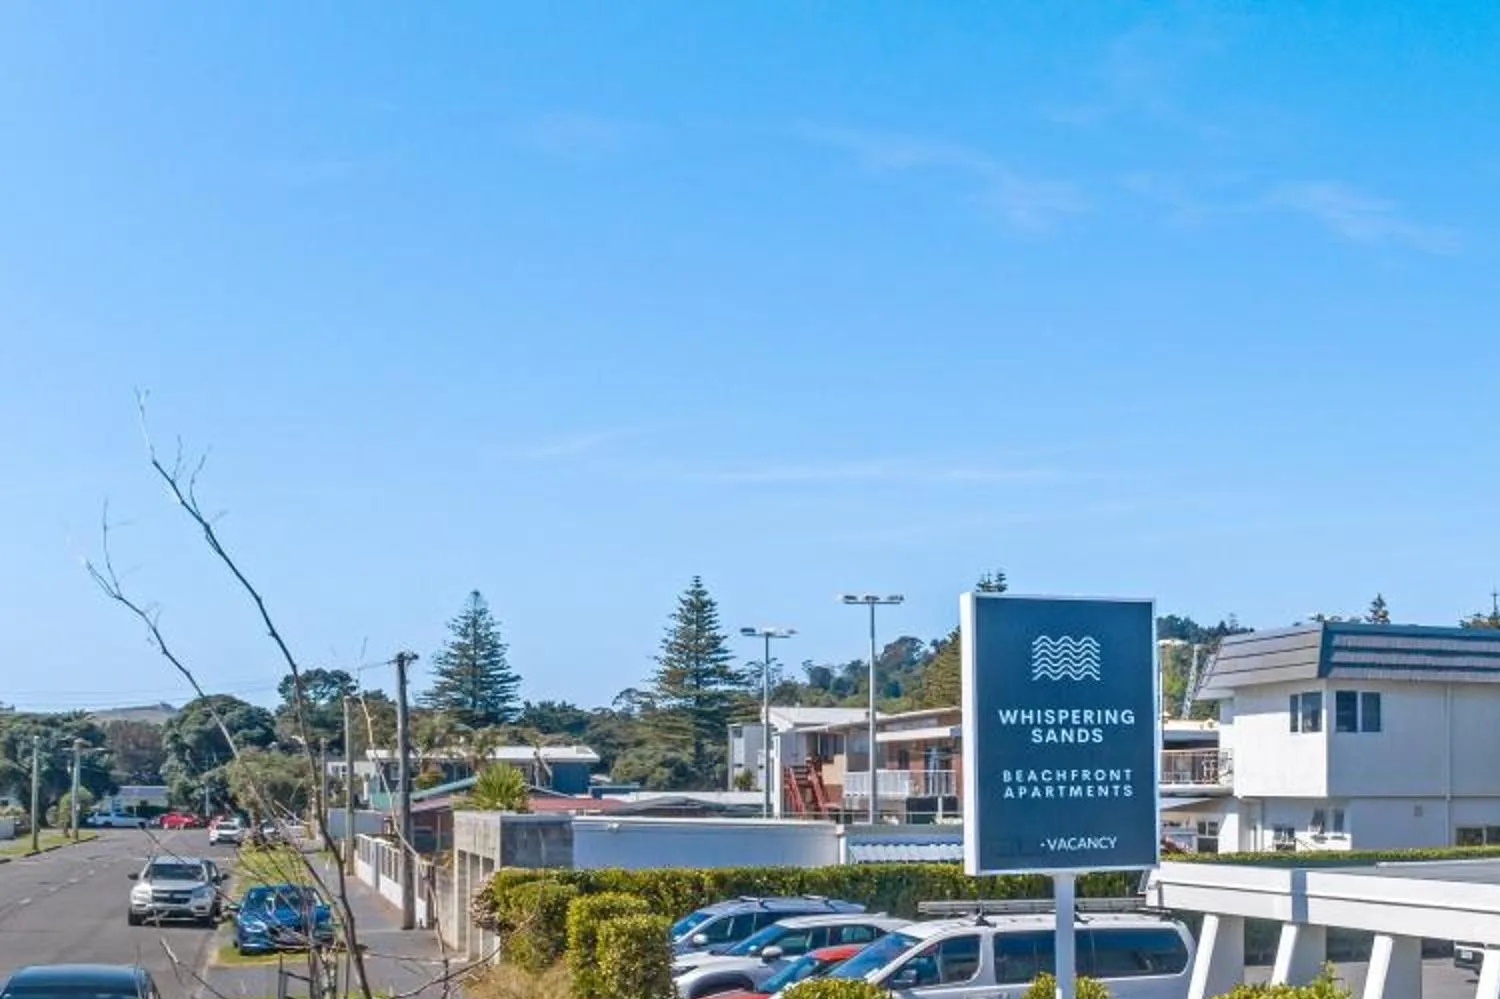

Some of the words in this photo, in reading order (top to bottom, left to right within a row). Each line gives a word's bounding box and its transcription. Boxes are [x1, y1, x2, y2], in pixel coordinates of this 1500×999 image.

[998, 709, 1136, 725] WHISPERING
[1031, 728, 1104, 743] SANDS
[1002, 769, 1134, 782] BEACHFRONT
[1004, 784, 1134, 799] APARTMENTS
